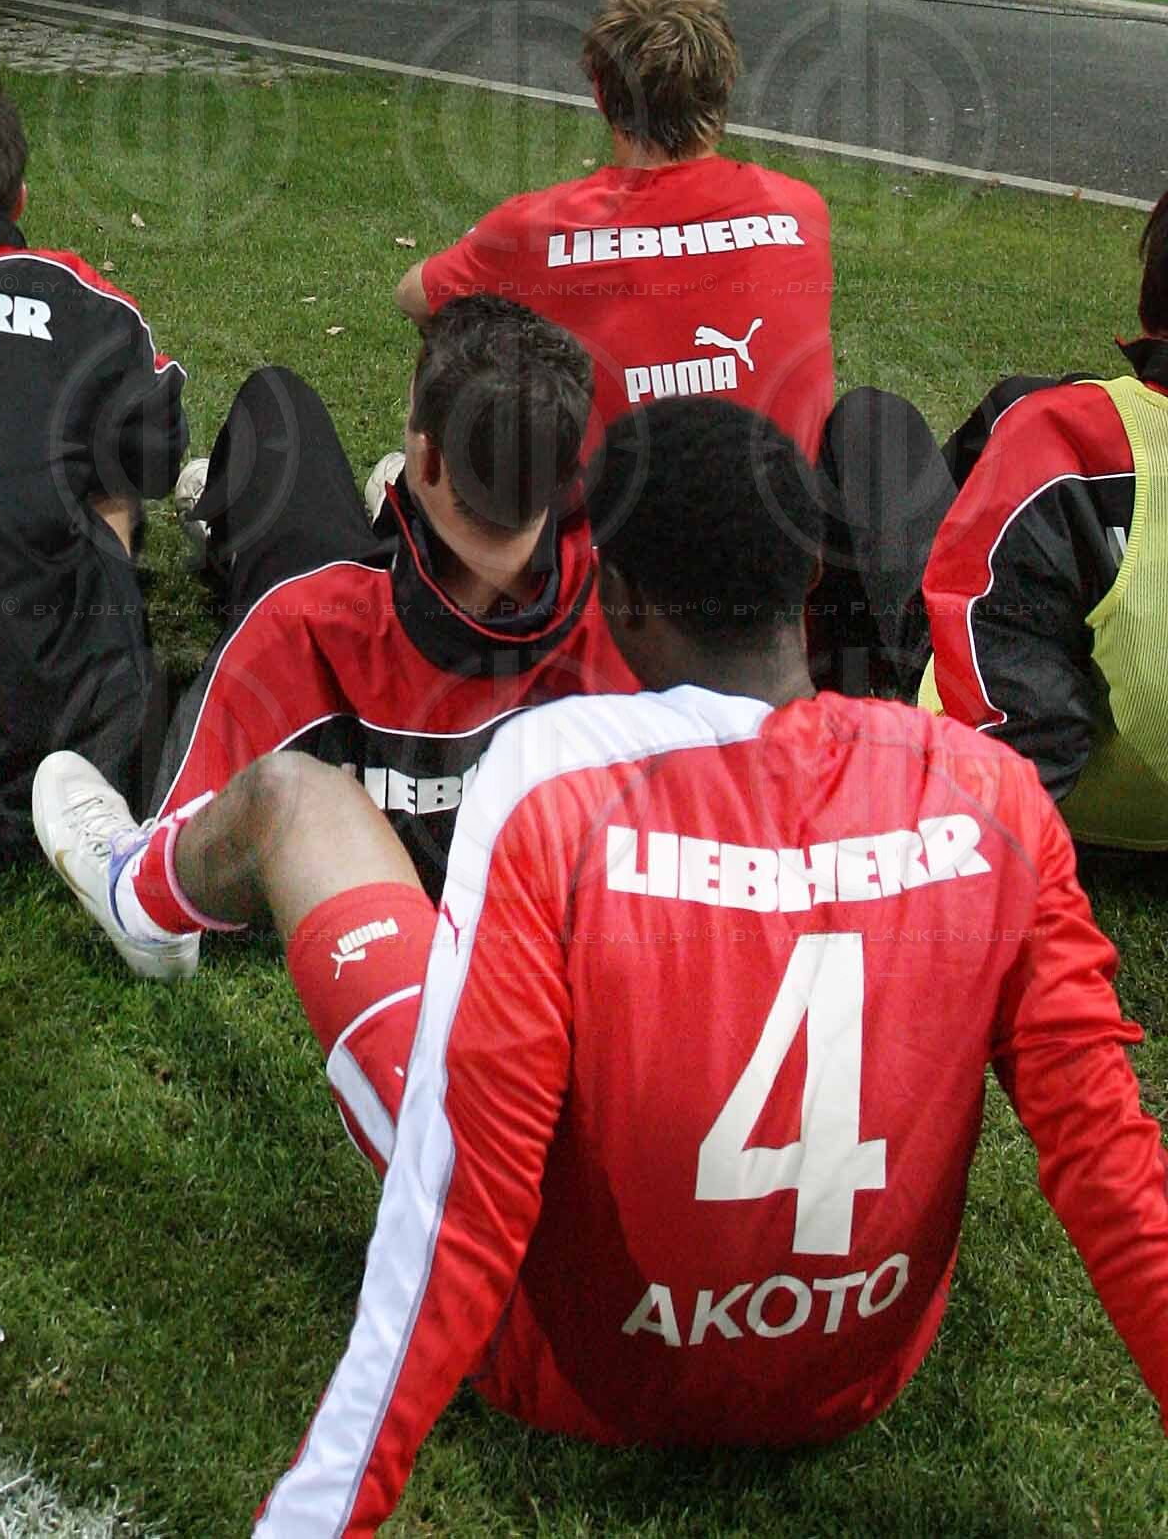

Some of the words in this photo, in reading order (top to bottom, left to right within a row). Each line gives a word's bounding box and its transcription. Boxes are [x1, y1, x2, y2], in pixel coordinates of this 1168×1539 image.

[547, 214, 805, 268] LIEBHERR
[624, 354, 738, 404] PUMA
[606, 813, 992, 914] LIEBHERR
[694, 932, 887, 1256] 4
[621, 1252, 910, 1348] AKOTO
